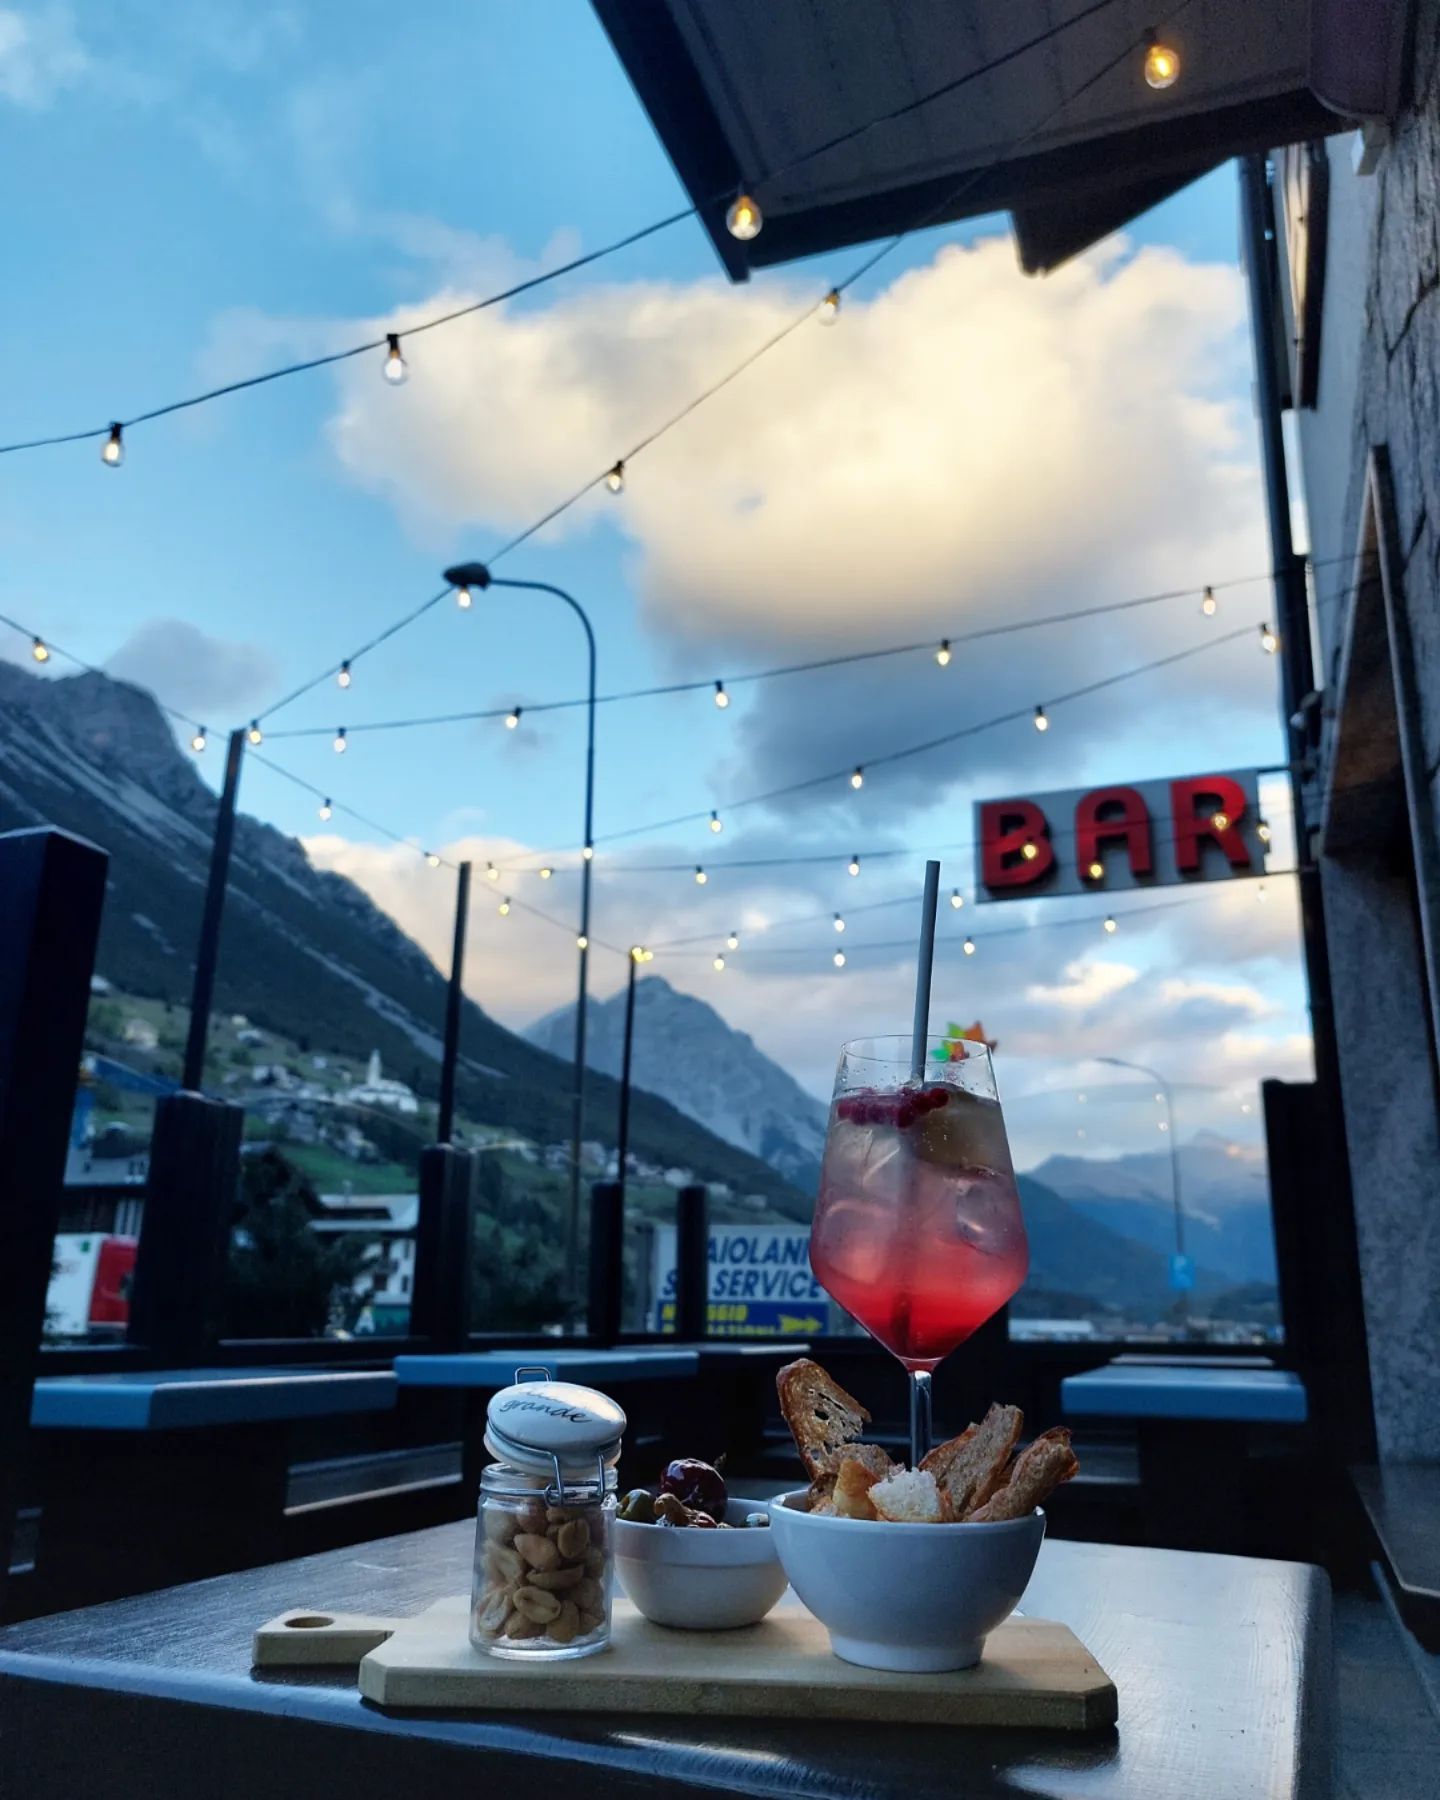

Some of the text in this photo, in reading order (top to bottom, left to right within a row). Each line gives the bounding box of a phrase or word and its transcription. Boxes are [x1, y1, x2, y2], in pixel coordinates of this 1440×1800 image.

[980, 775, 1250, 887] BAR
[707, 1236, 810, 1265] AIOLANI
[712, 1269, 820, 1298] SERVICE
[499, 1399, 593, 1423] grande
